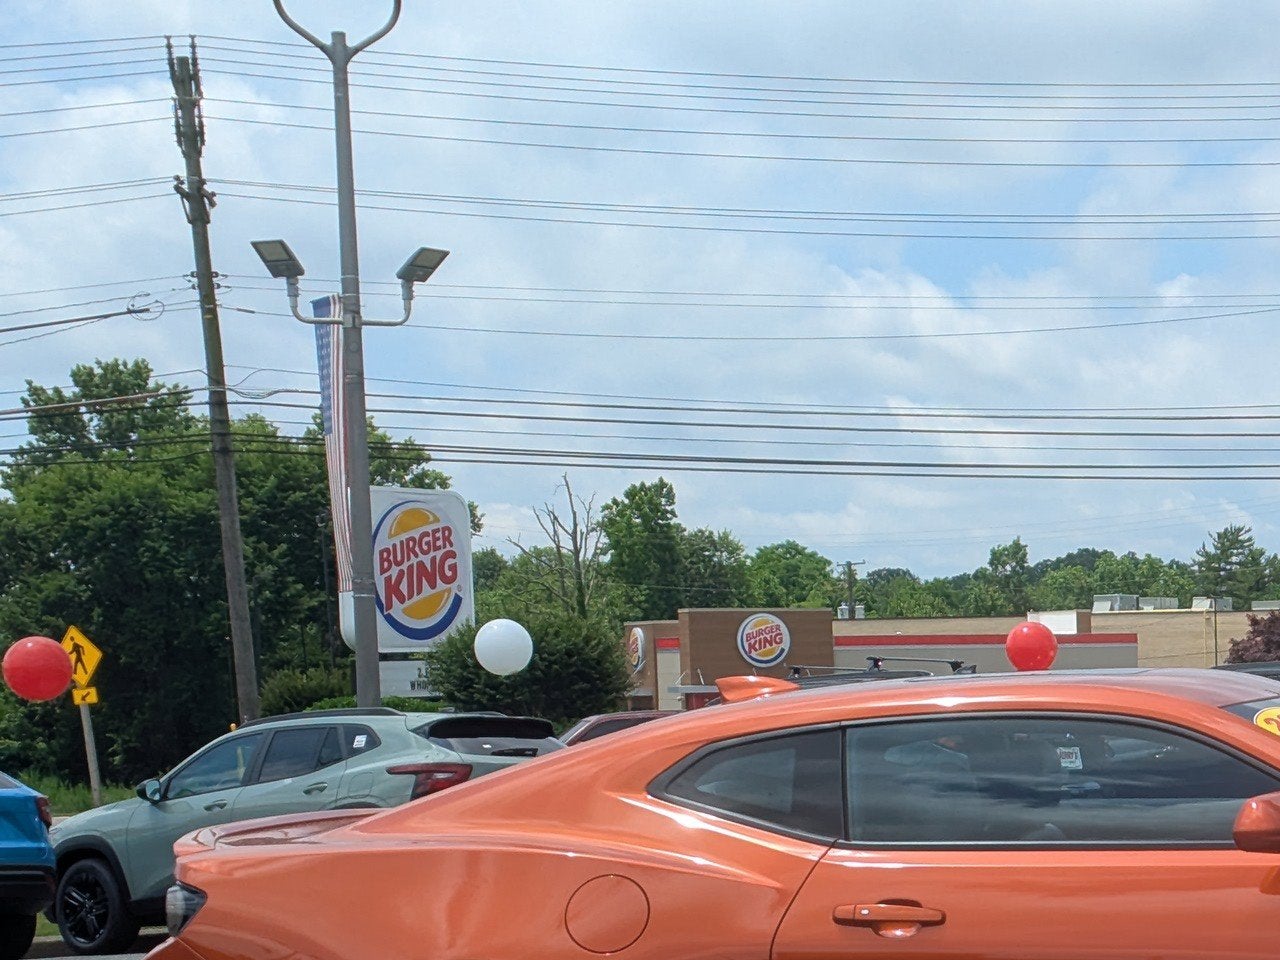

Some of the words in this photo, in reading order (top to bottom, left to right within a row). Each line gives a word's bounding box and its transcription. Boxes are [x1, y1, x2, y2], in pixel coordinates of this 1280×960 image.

[378, 525, 454, 576] BURGER
[384, 549, 458, 613] KING
[745, 623, 782, 643] BURGER
[747, 632, 784, 655] KING
